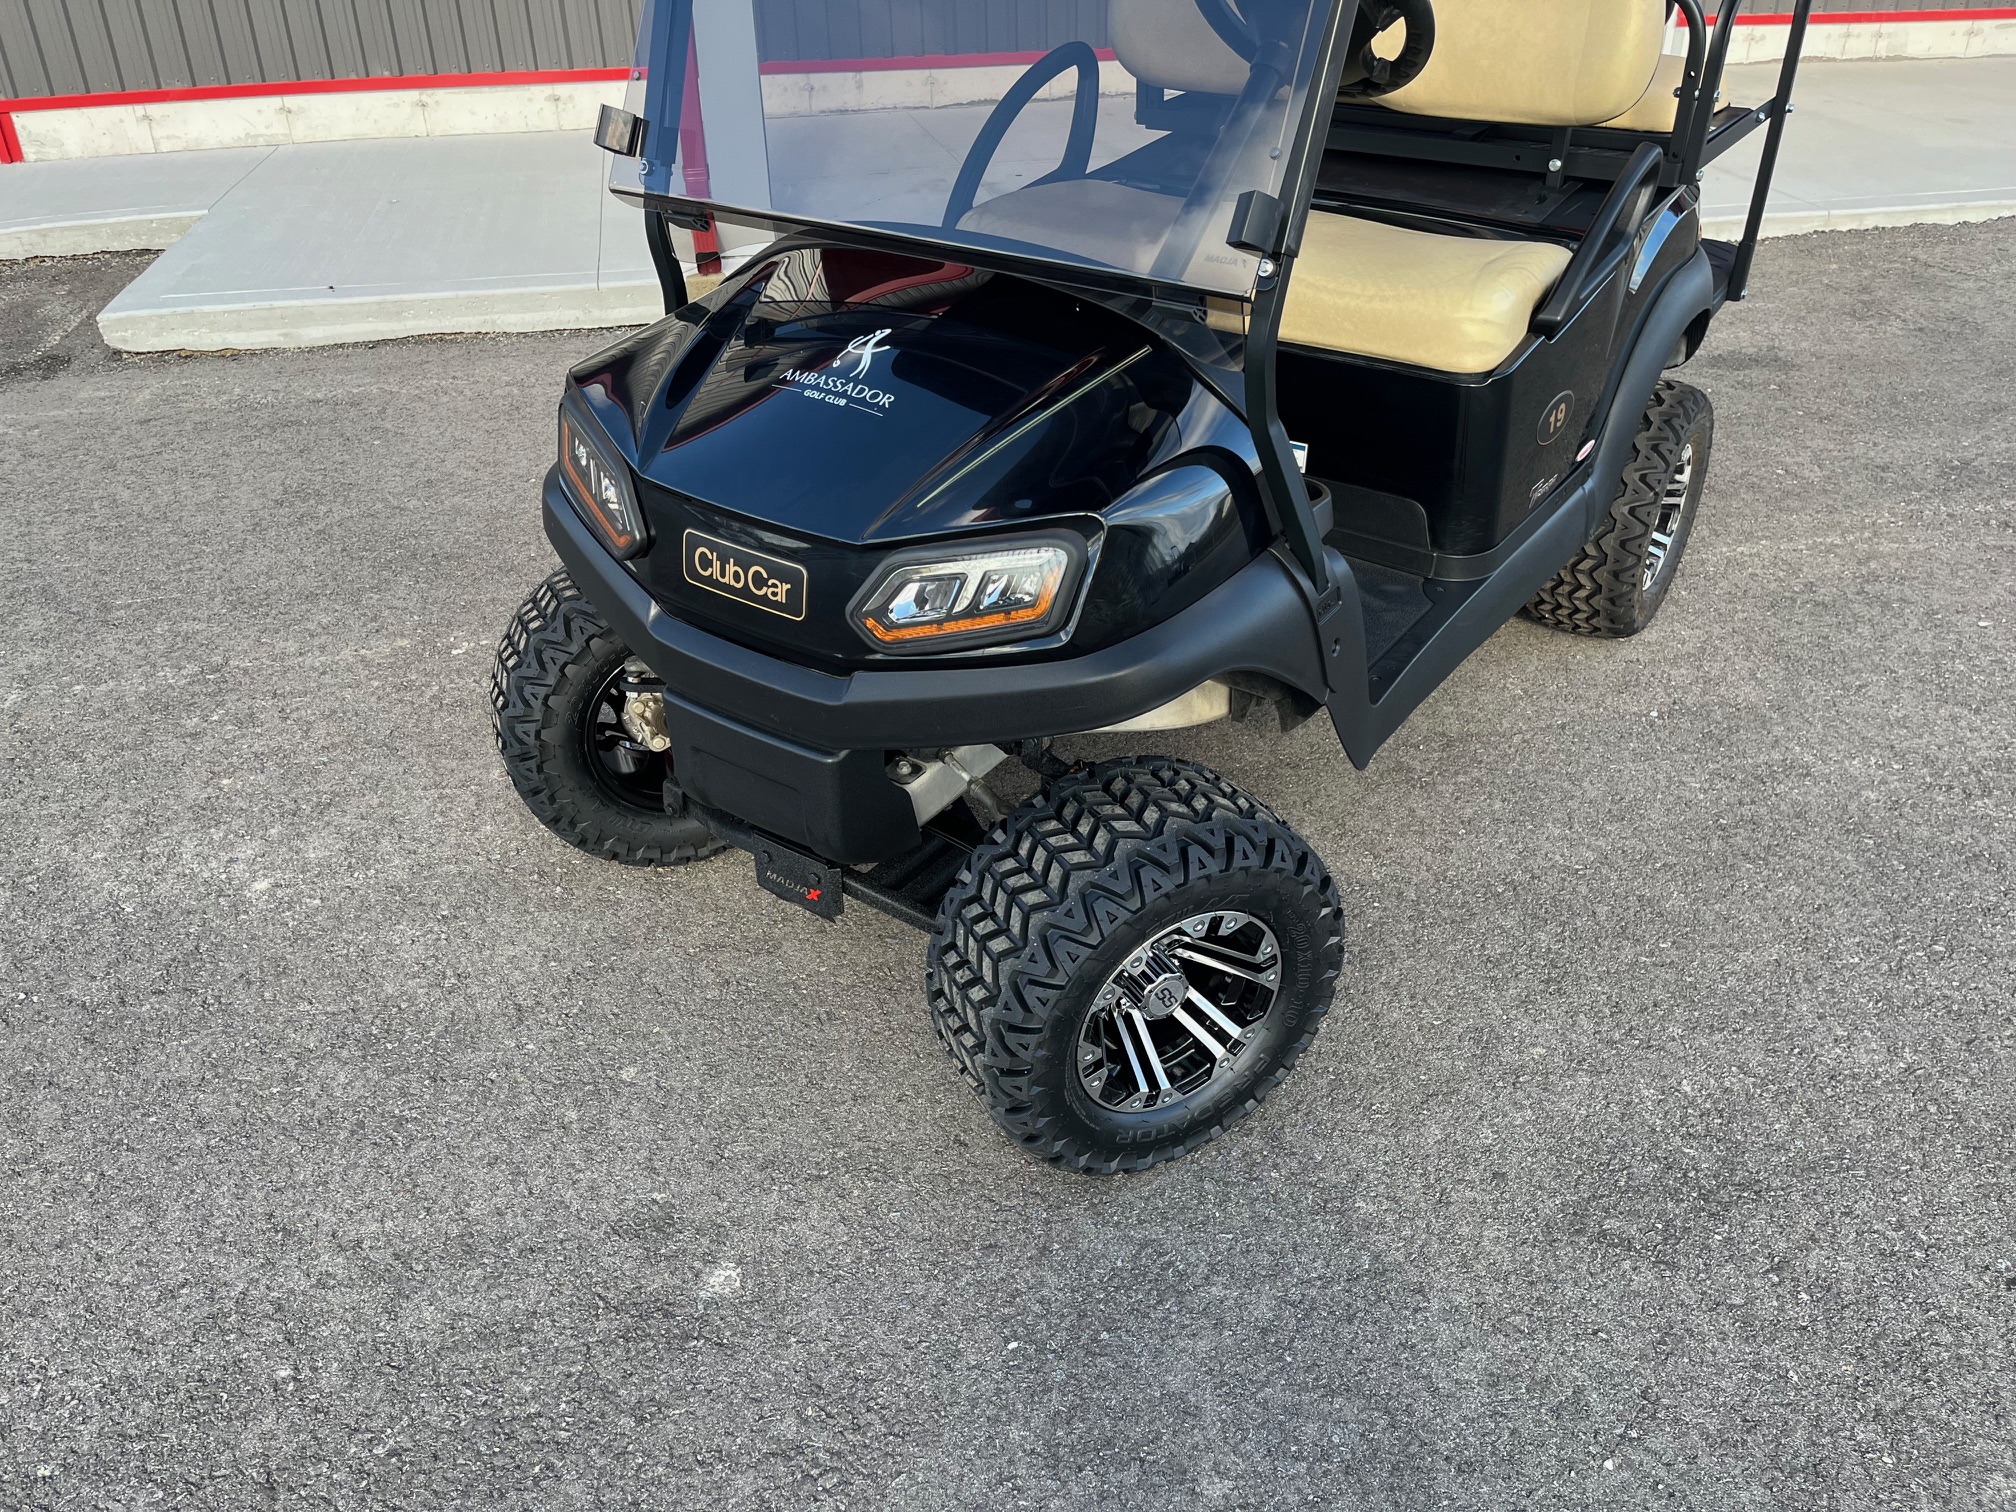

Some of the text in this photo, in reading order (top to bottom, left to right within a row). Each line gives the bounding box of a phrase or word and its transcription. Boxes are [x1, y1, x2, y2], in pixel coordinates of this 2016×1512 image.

[780, 368, 895, 408] AMBASSADOR
[803, 389, 847, 406] GOLF CLUB
[1549, 402, 1566, 434] 19
[694, 546, 791, 604] Club Car
[766, 870, 822, 901] MADJAX
